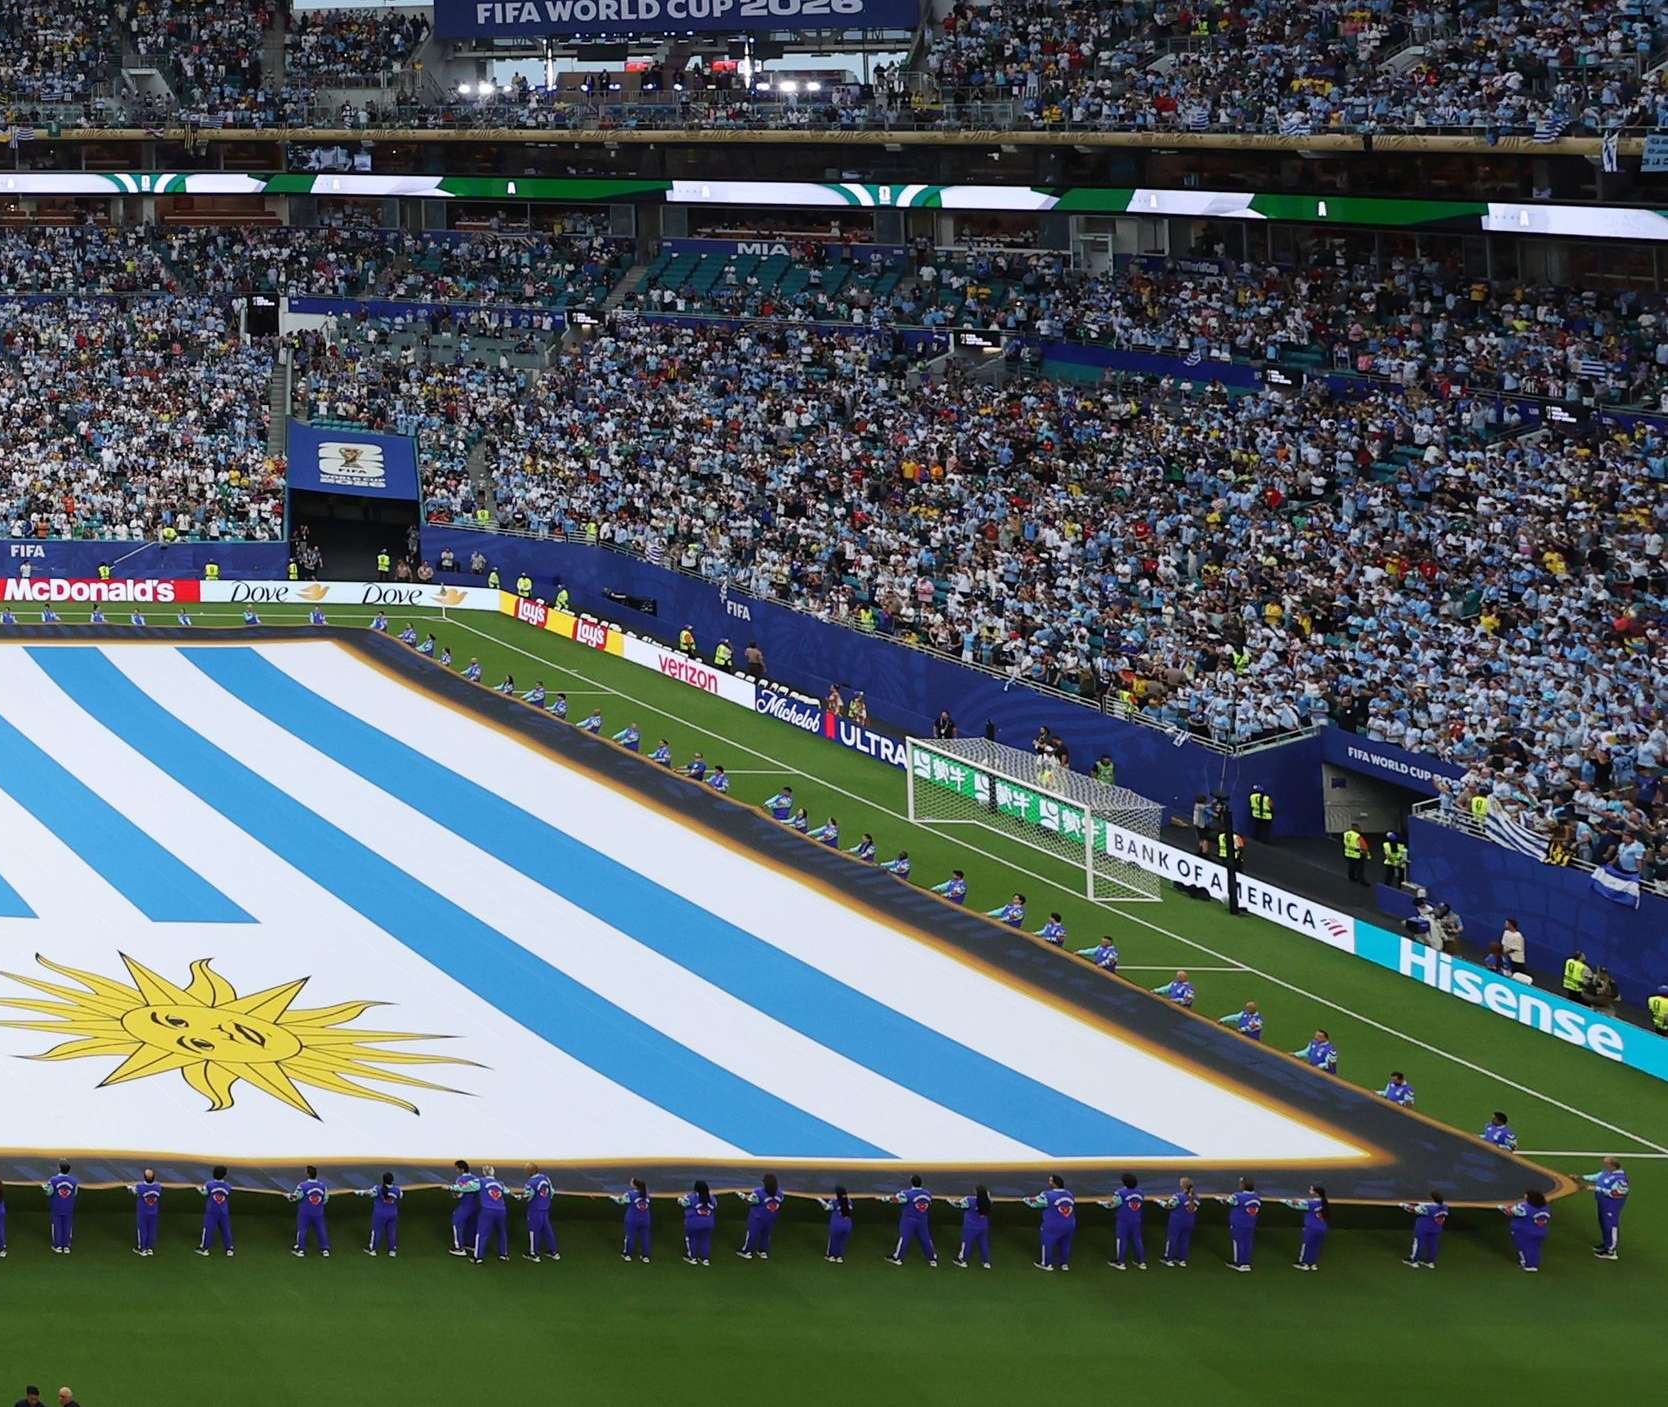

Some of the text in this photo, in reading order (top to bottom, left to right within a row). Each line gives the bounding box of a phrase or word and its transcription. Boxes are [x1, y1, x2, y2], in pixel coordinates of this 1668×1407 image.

[476, 1, 545, 24] FIFA
[10, 545, 45, 558] FIFA
[4, 578, 175, 603] McDonald's
[231, 581, 289, 603] Dove
[363, 583, 423, 605] Dove
[517, 597, 546, 623] Lay's
[726, 599, 751, 622] FIFA
[576, 619, 605, 646] Lay's
[659, 653, 718, 694] verizon
[756, 689, 907, 770] Michelob ULTRA
[1348, 746, 1432, 781] FIFA WORLD CUP
[1114, 833, 1170, 871] BANK
[1177, 858, 1204, 882] OF
[1399, 935, 1625, 1063] Hisense
